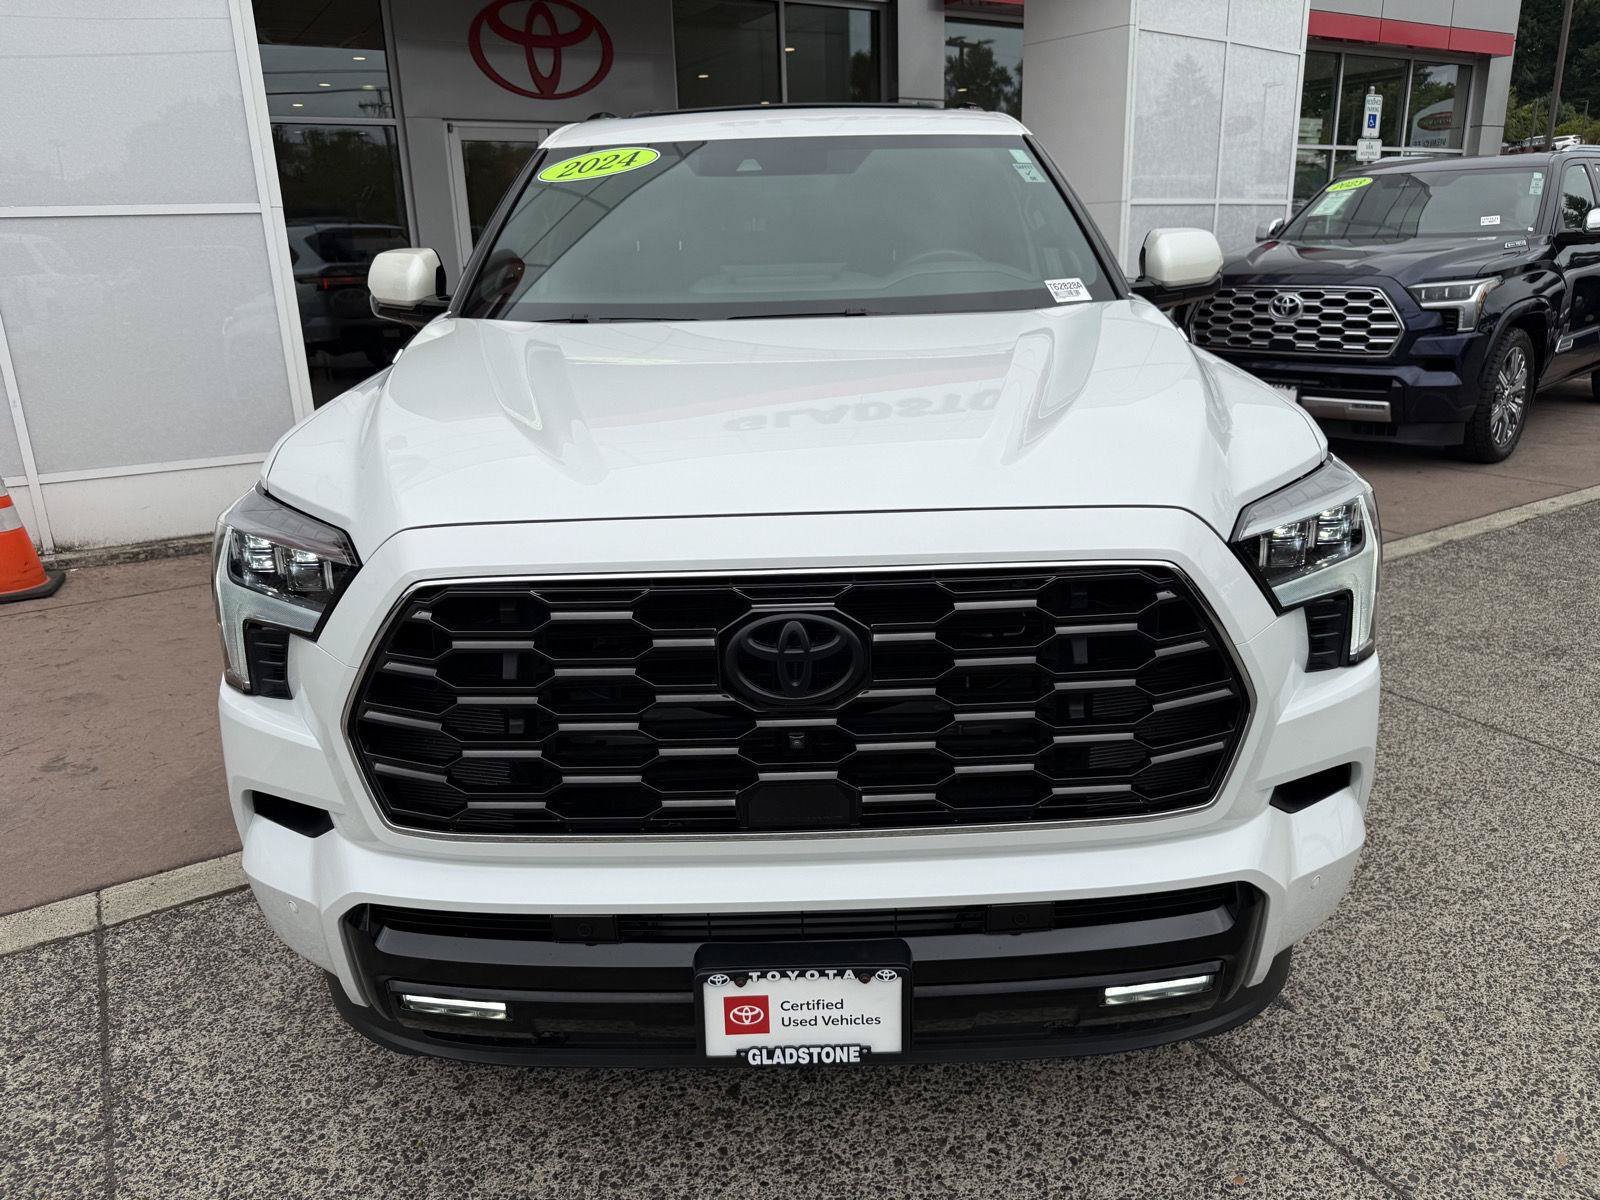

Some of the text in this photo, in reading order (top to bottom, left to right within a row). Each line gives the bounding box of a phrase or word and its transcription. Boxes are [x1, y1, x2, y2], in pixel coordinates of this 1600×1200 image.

[556, 150, 641, 178] 2024
[749, 969, 856, 983] TOYOTA
[780, 998, 844, 1012] Certified
[781, 1014, 881, 1027] Used Vehicles
[747, 1046, 861, 1066] GLADSTONE
